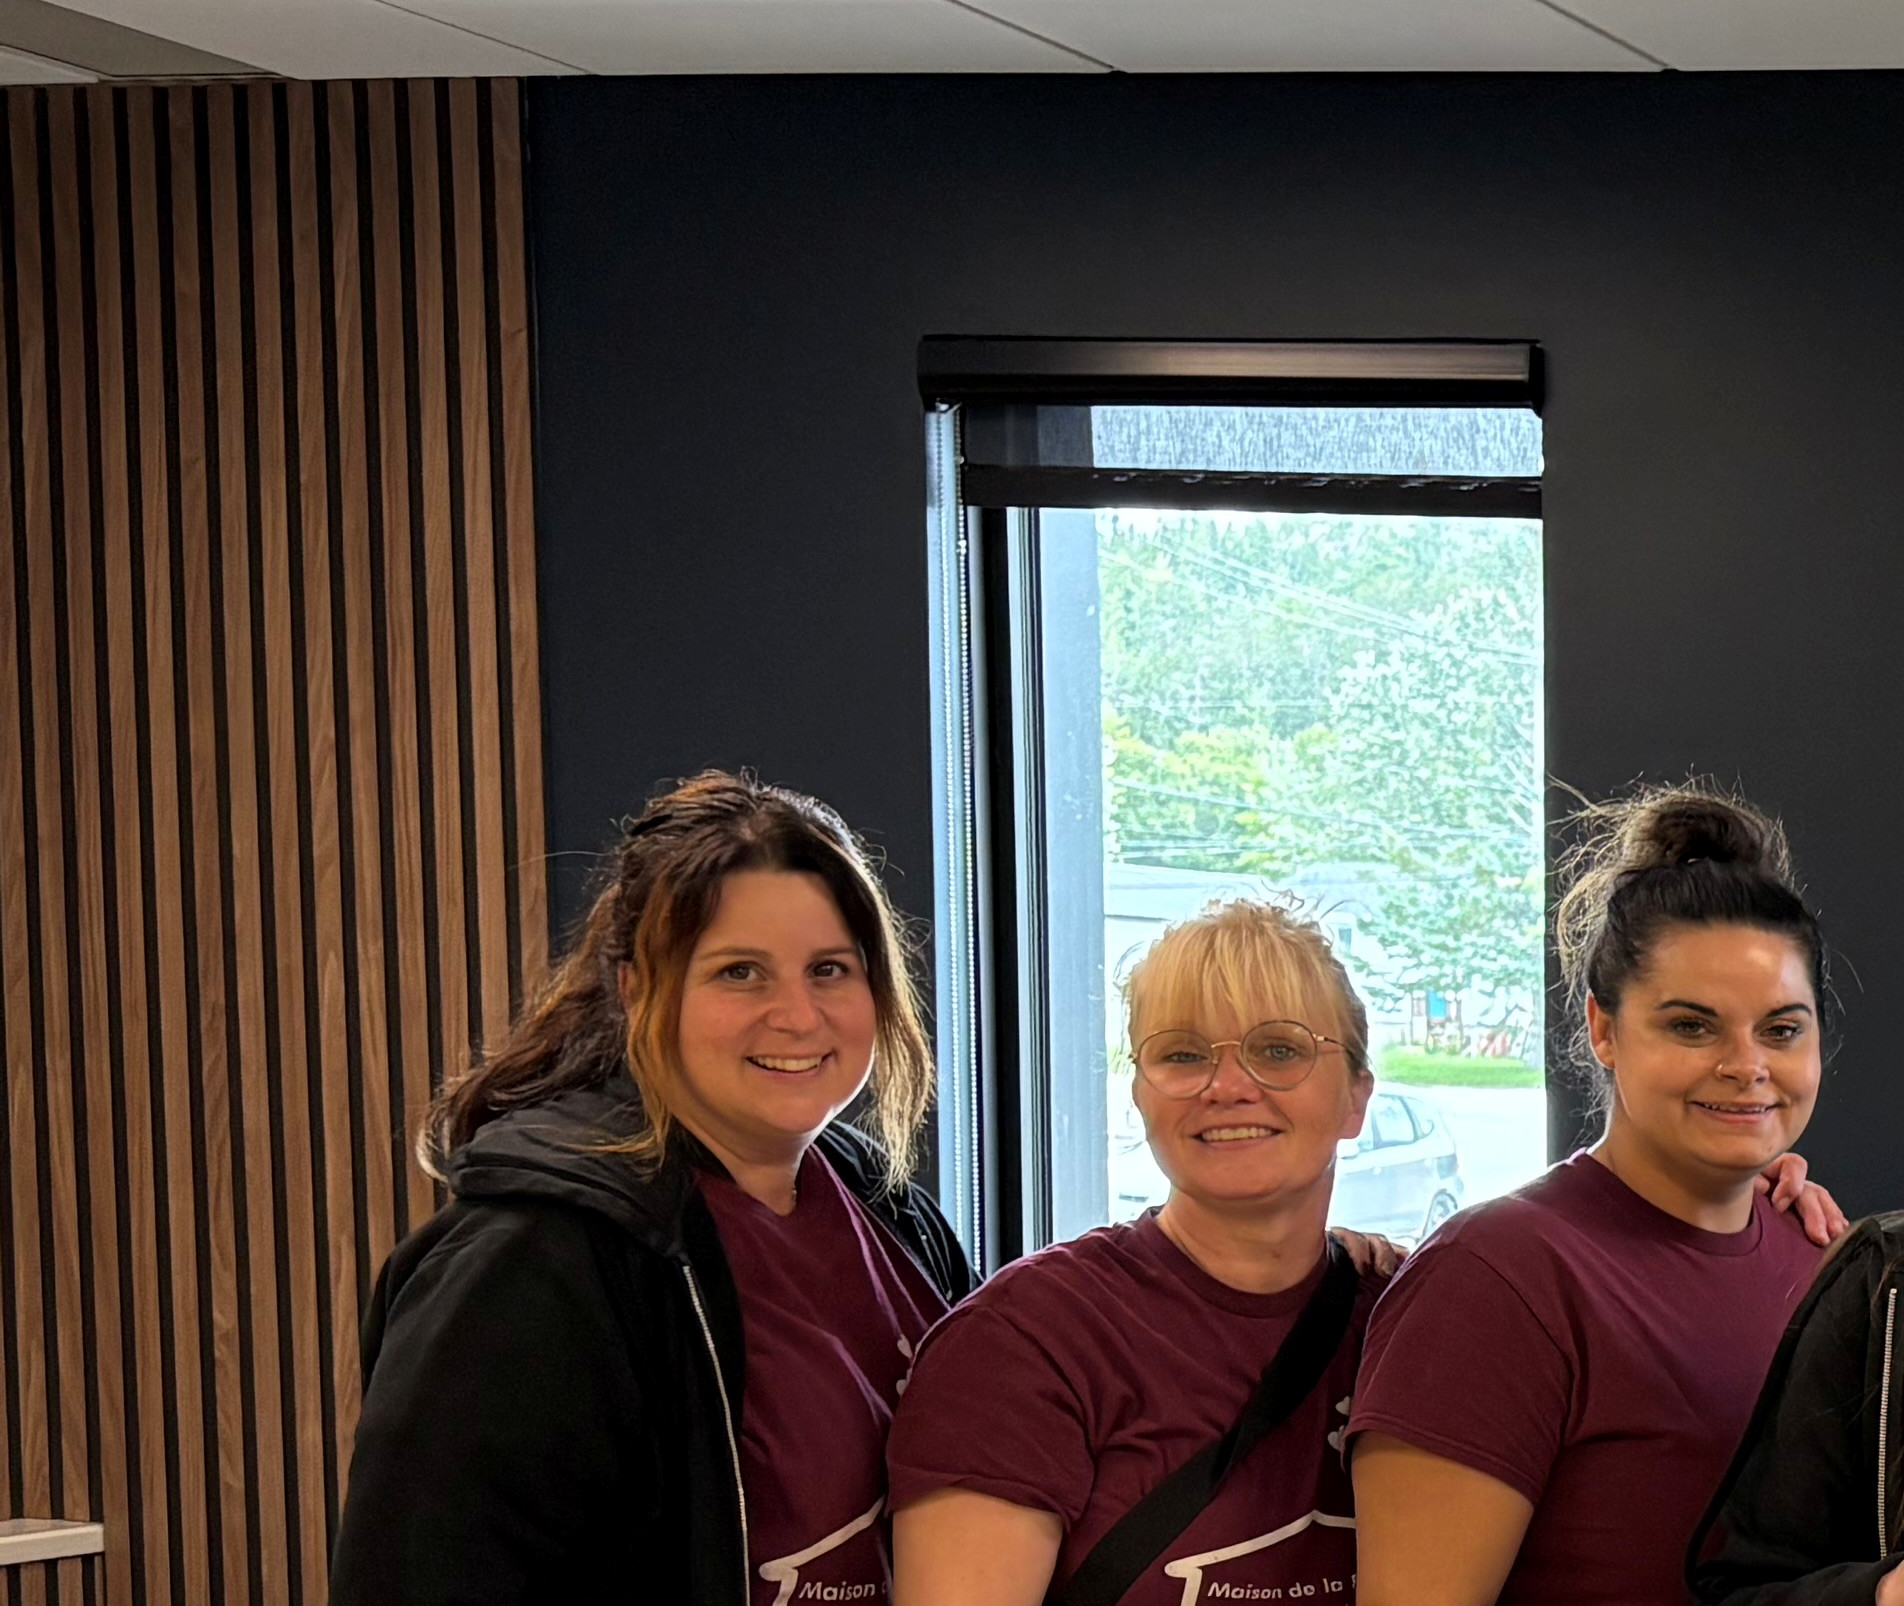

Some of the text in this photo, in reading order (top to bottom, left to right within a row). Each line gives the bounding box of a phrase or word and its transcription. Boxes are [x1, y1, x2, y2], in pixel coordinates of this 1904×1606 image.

[798, 1581, 876, 1601] Maison
[1207, 1582, 1282, 1600] Maison
[1322, 1578, 1344, 1594] la
